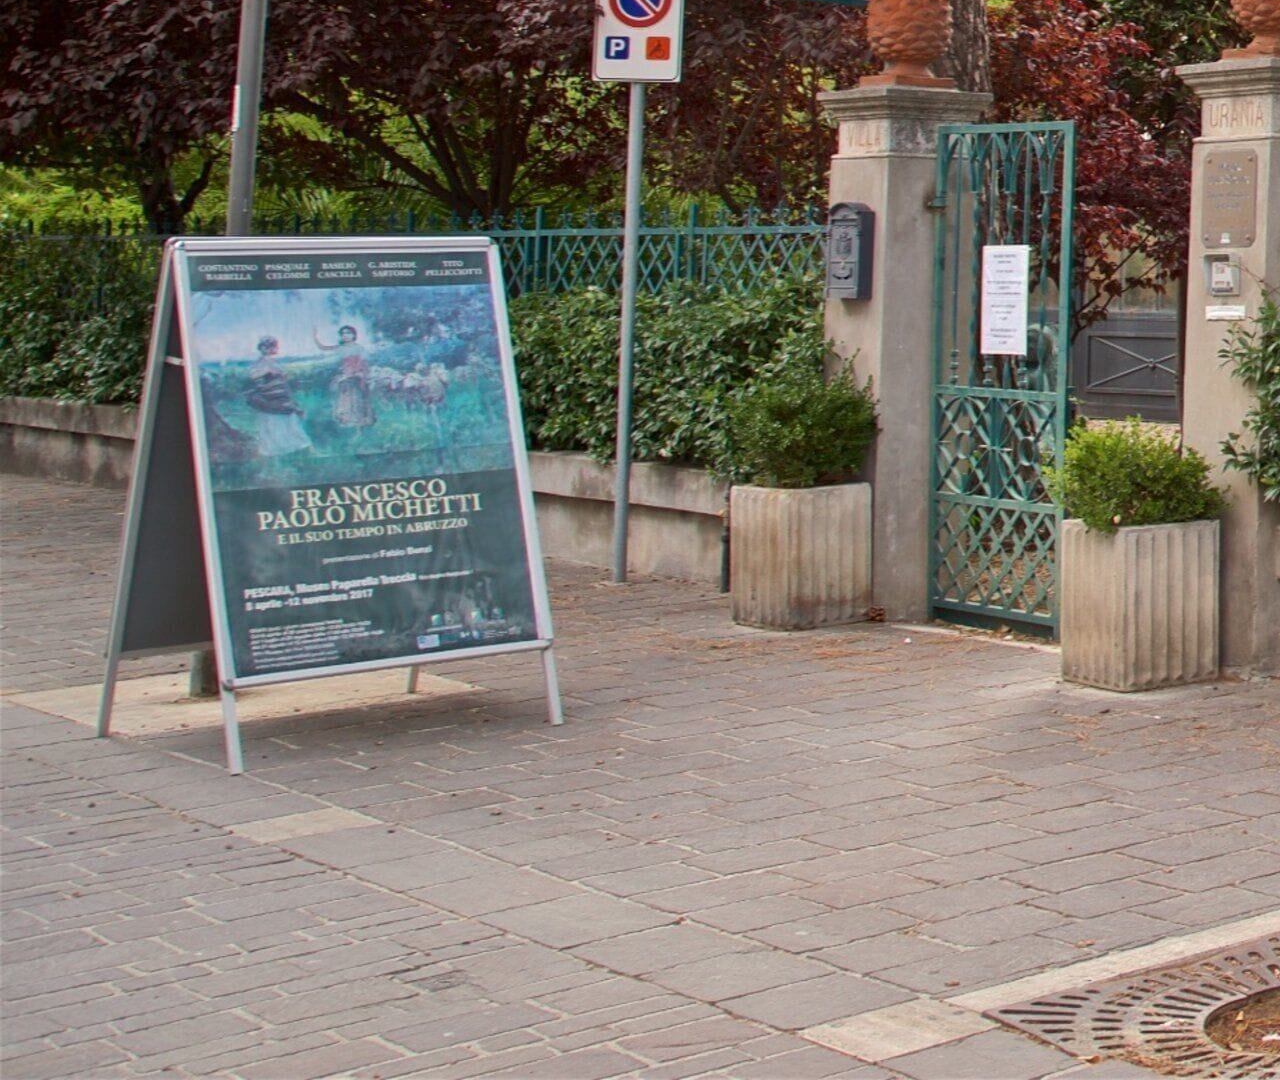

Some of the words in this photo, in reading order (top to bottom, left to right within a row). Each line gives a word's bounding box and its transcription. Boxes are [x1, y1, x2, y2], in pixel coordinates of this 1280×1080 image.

[609, 39, 626, 57] P
[1207, 101, 1264, 128] URANIA
[290, 478, 448, 509] FRANCESCO
[257, 505, 346, 531] PAOLO
[351, 493, 483, 524] MICHETTI
[278, 533, 288, 545] E
[289, 532, 305, 544] IL
[305, 530, 334, 543] SUO
[335, 525, 385, 541] TEMPO
[386, 522, 402, 535] IN
[404, 517, 469, 534] ABRUZZO
[243, 585, 295, 600] PESCARA,
[349, 588, 374, 601] 2017
